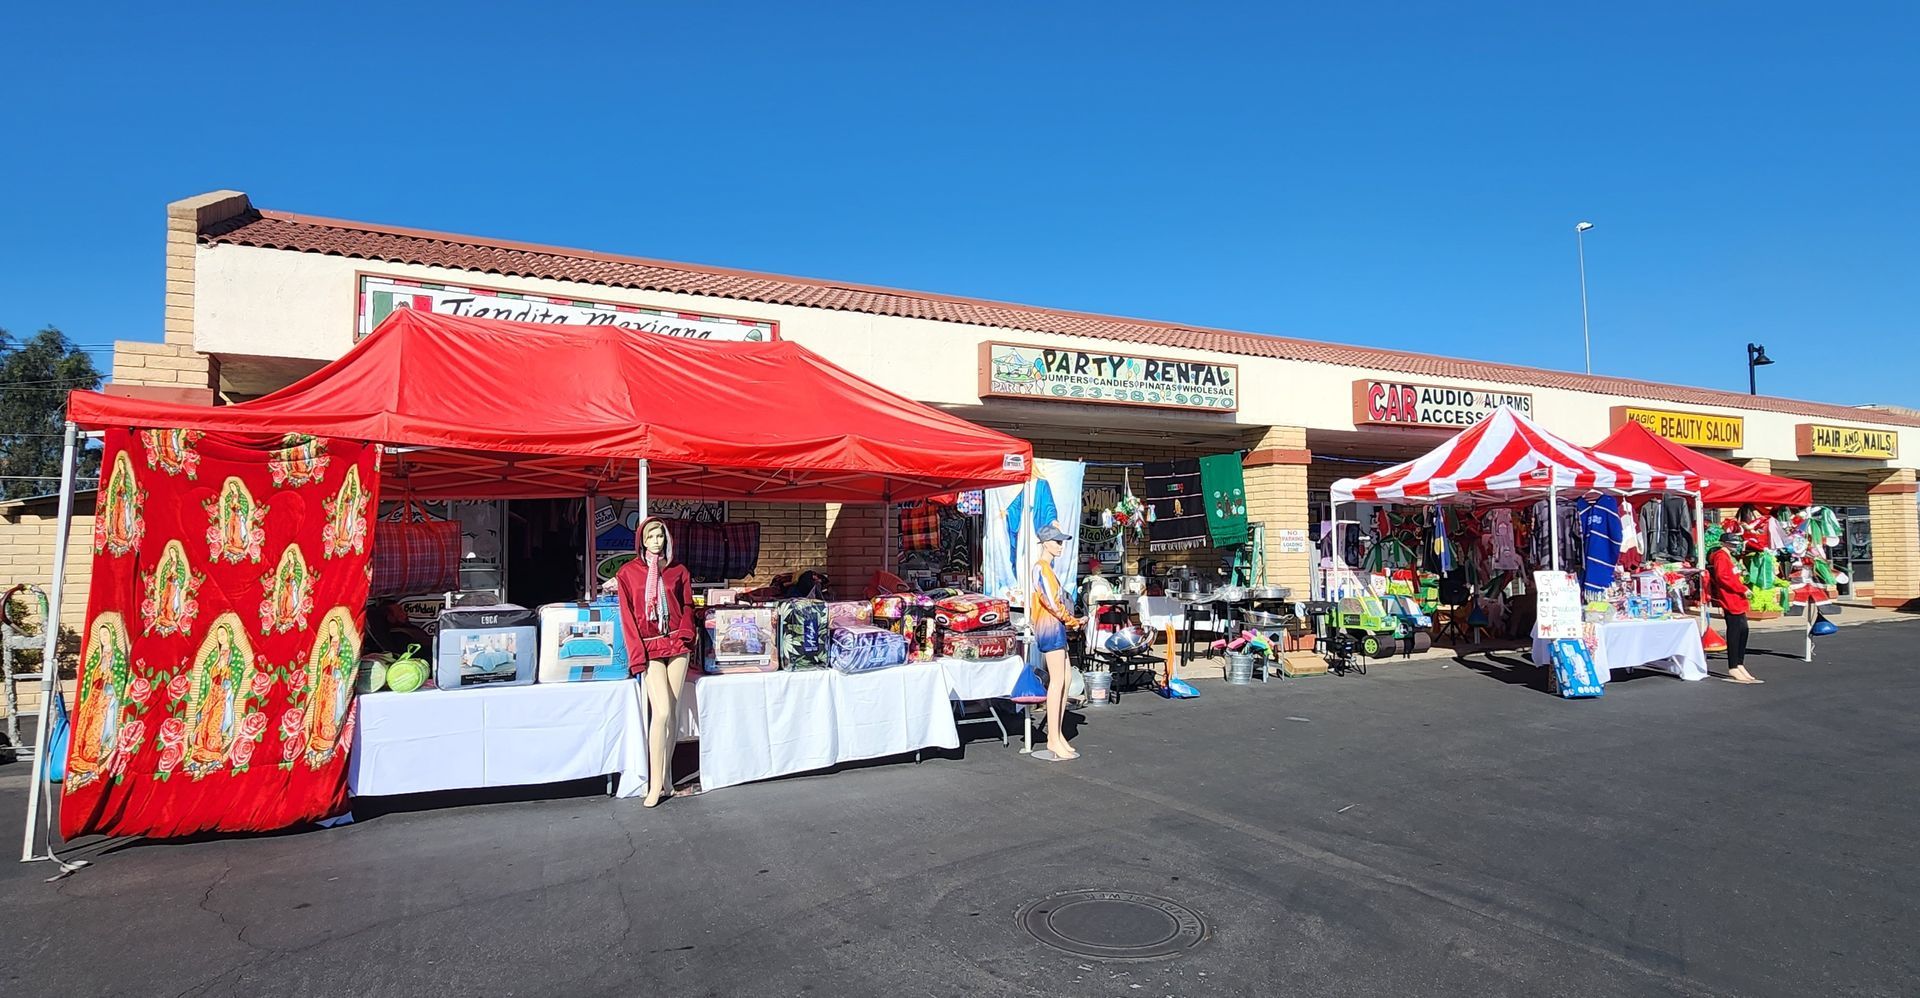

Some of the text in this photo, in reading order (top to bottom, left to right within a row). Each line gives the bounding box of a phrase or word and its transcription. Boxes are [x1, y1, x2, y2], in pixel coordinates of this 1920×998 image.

[440, 297, 570, 325] Tiendita
[1043, 349, 1231, 387] PARTY RENTAL
[991, 381, 1032, 394] PARTY
[1042, 374, 1235, 396] JUMPERS CANDIES PINATAS WHOLESALE
[1051, 384, 1235, 408] 623-583-9070
[1368, 382, 1418, 422] CAR
[1421, 389, 1530, 412] AUDIO ALARMS
[1628, 413, 1656, 424] MAGIC
[1661, 417, 1740, 443] BEAUTY SALON
[1817, 428, 1891, 451] HAIR AND NAILS
[1079, 527, 1110, 541] araoke
[403, 602, 436, 616] Birthday
